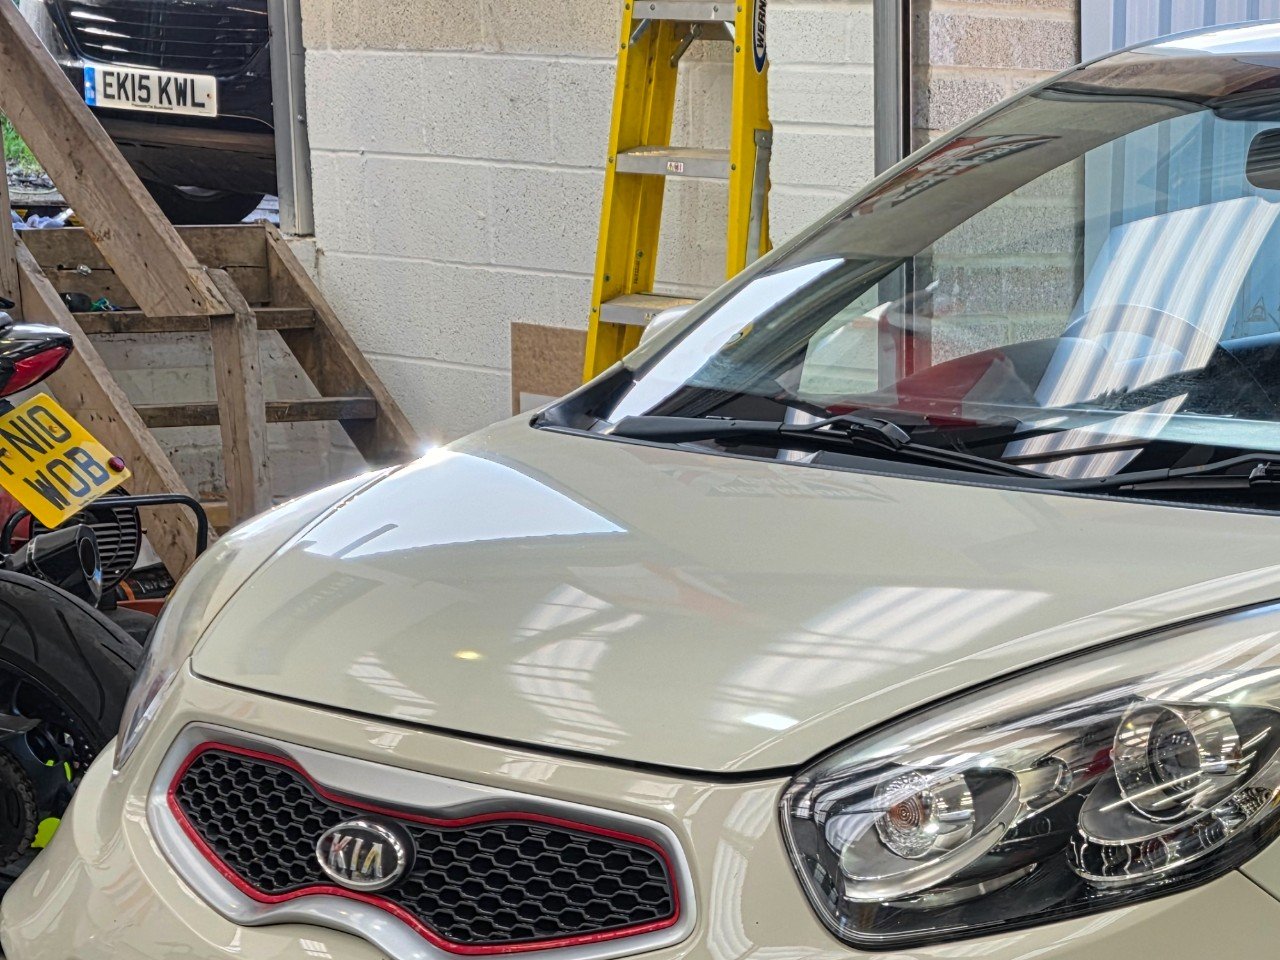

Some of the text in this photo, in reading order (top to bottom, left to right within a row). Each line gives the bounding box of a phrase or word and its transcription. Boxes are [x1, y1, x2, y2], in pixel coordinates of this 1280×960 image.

[756, 0, 767, 48] WERN
[103, 71, 206, 108] EK15 KWL
[22, 446, 110, 511] WOB
[329, 832, 383, 878] KIA
